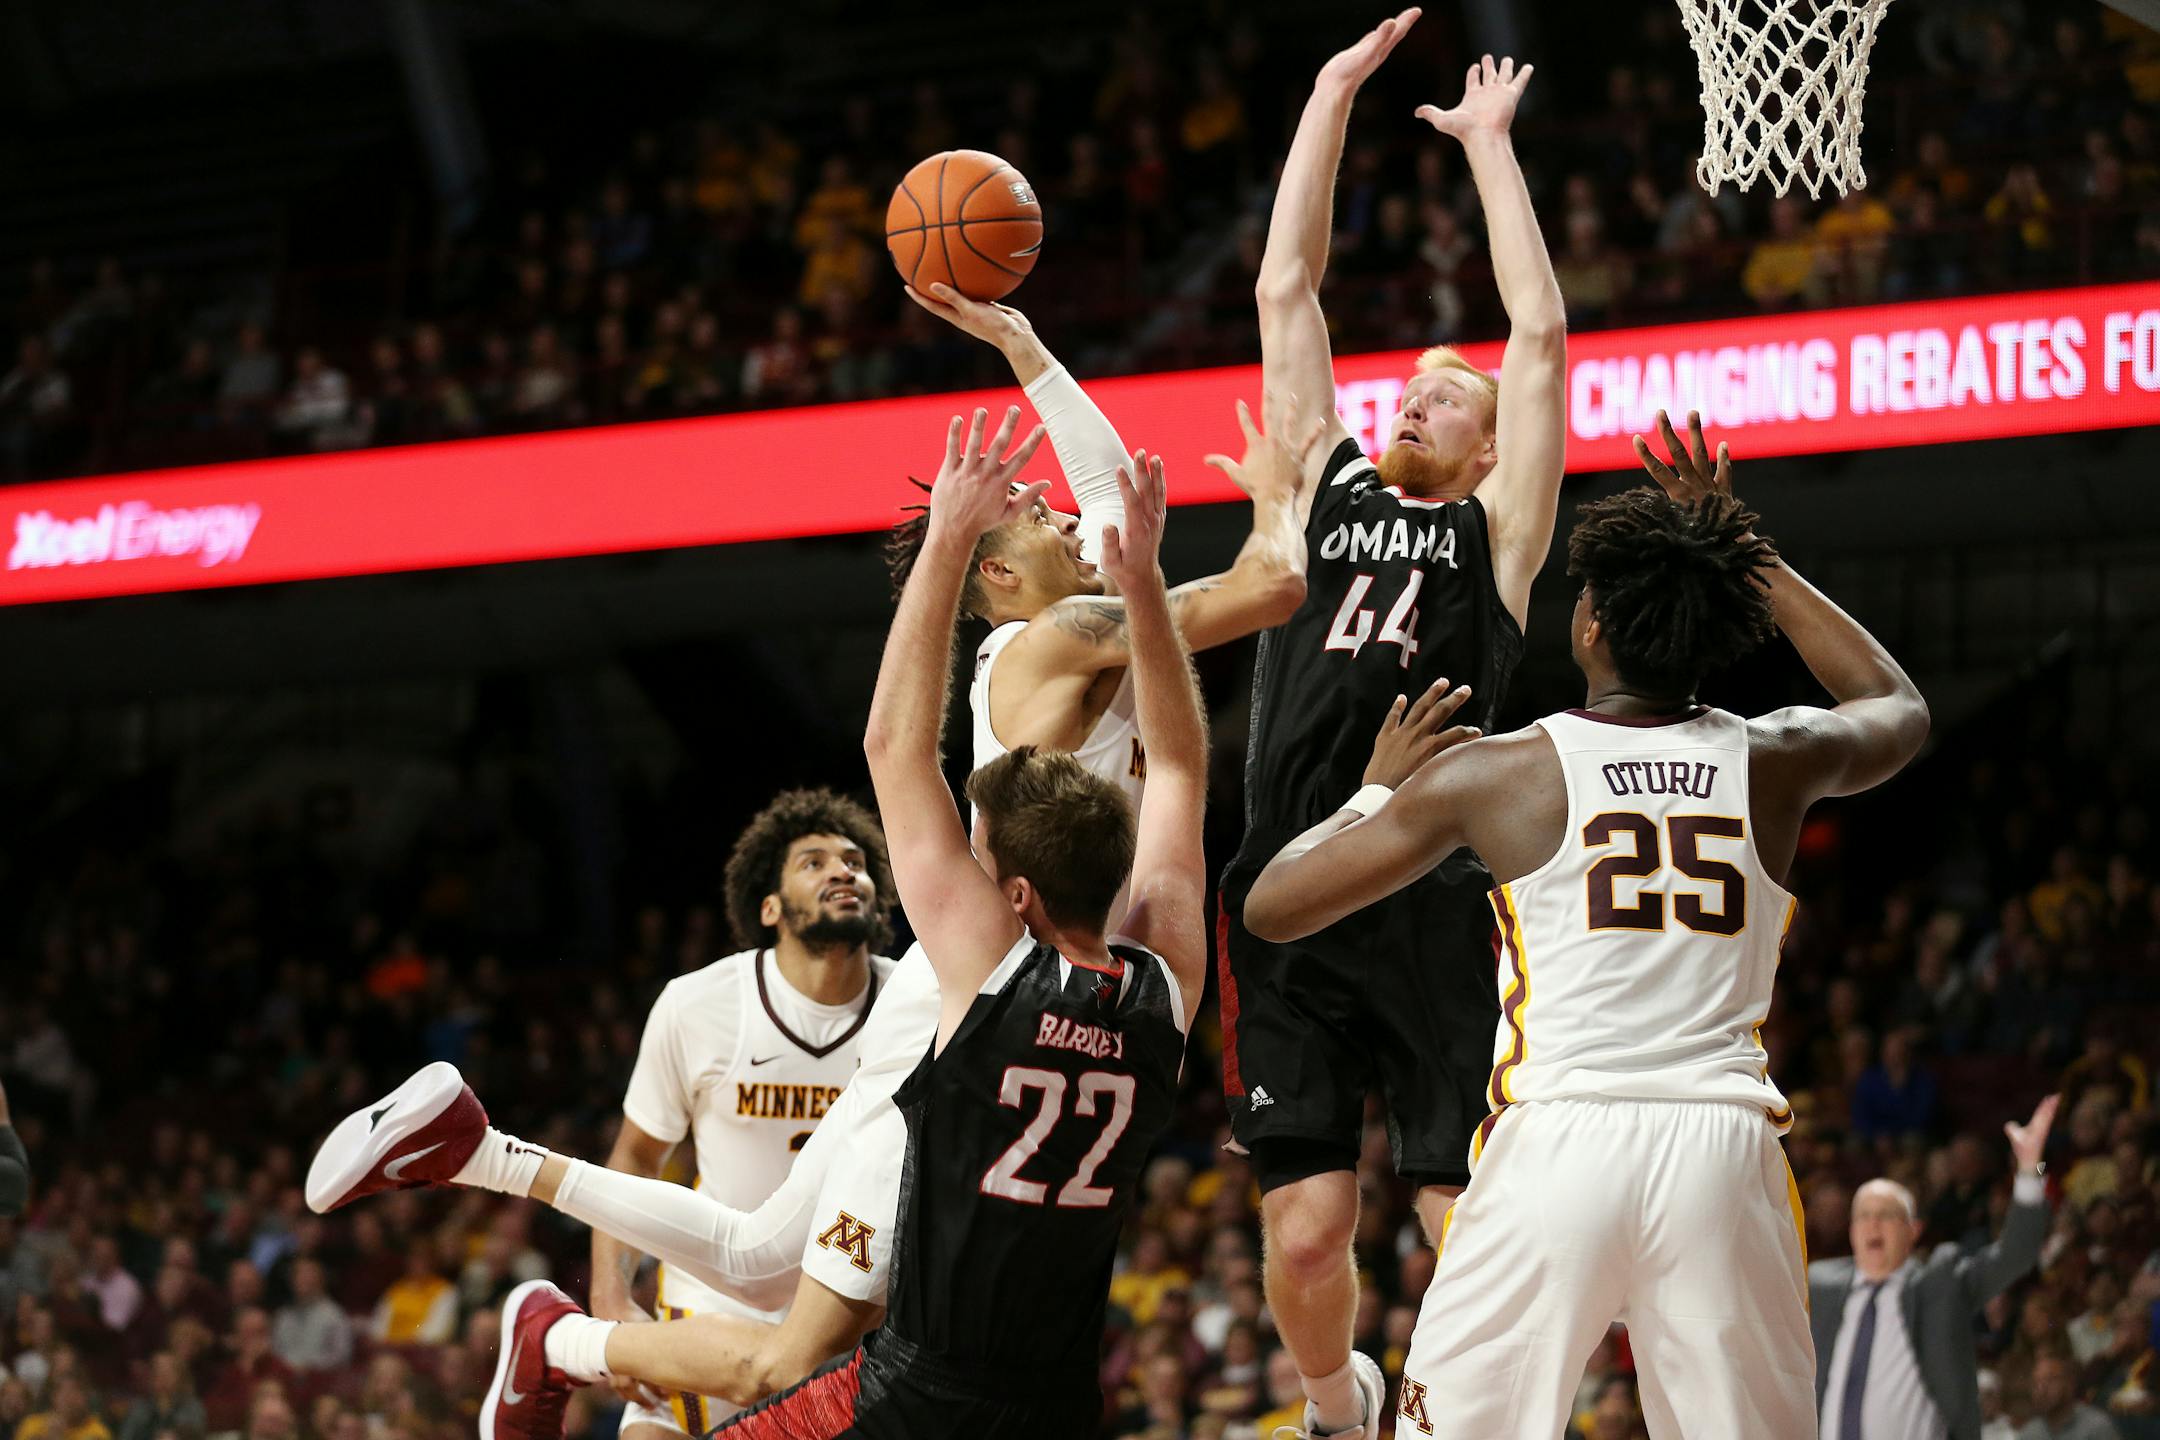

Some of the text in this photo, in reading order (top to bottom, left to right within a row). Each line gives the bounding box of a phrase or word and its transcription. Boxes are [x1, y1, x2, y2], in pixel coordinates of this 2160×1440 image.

[1571, 338, 1838, 441] CHANGING
[1850, 316, 2087, 415] REBATES
[1320, 518, 1458, 569] OMAHA
[1324, 568, 1424, 669] 44
[1602, 762, 1718, 799] OTURU
[1581, 811, 1747, 938] 25
[1035, 1012, 1124, 1060] BARNEY
[979, 1066, 1136, 1208] 22
